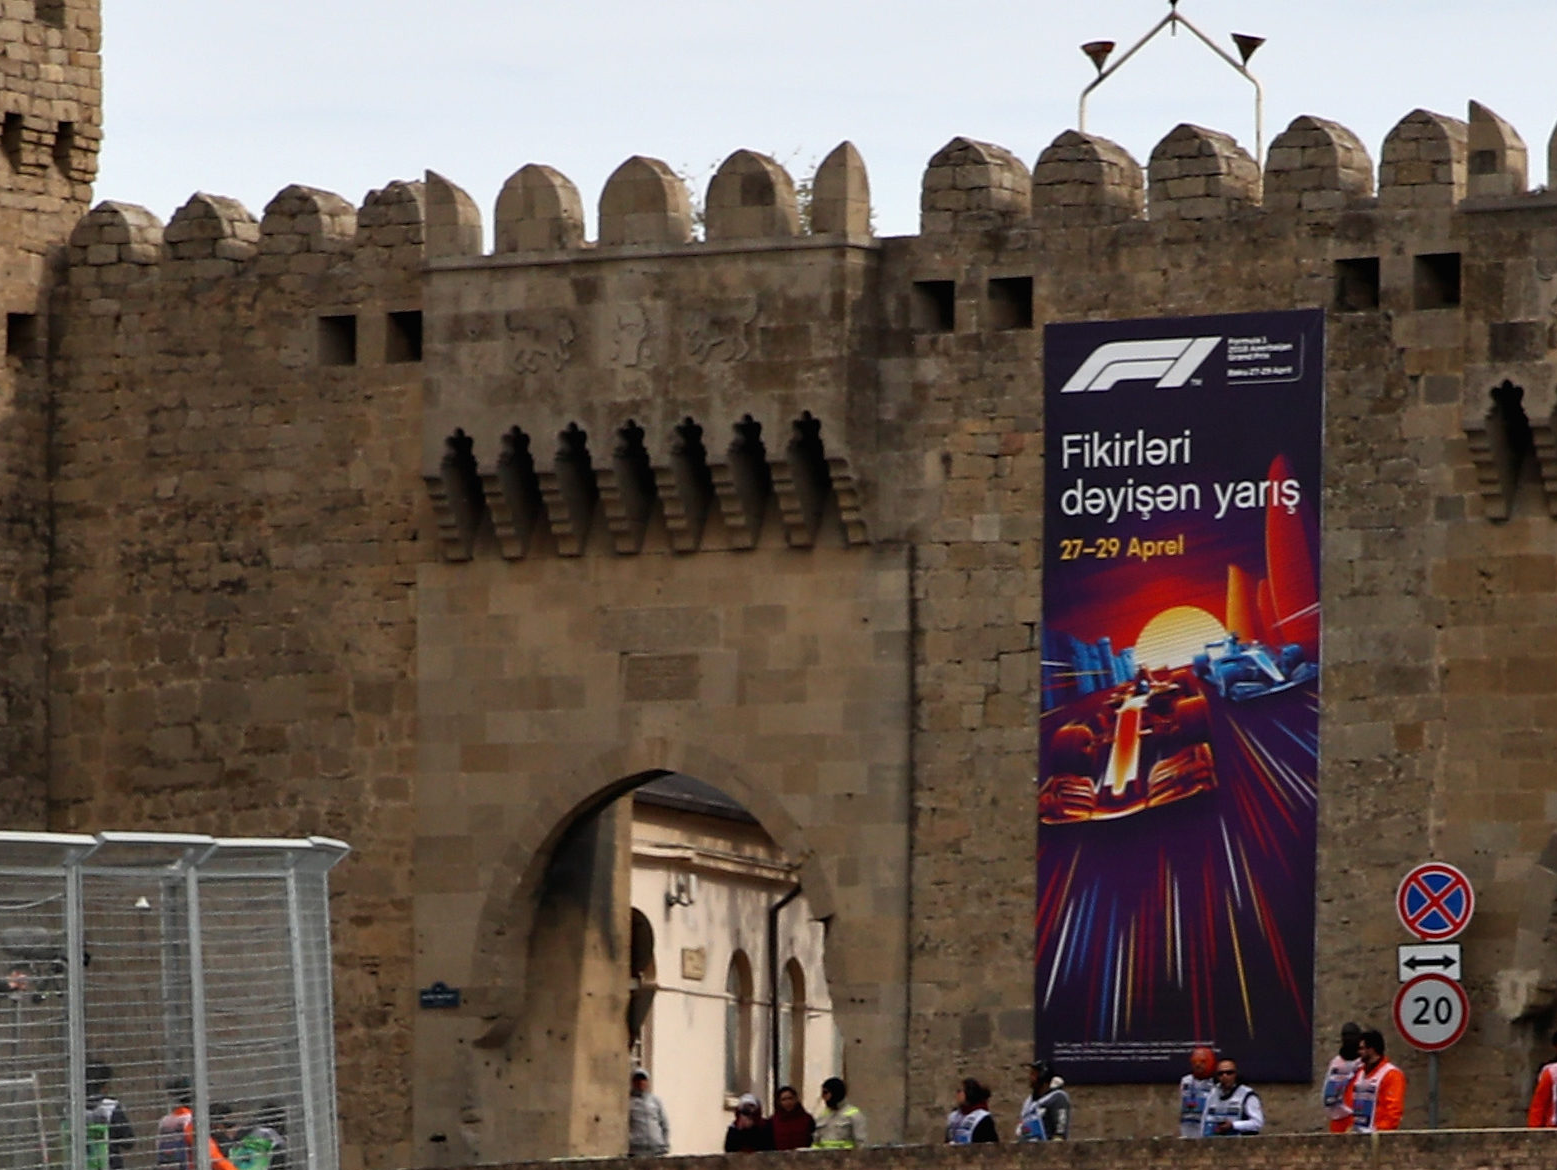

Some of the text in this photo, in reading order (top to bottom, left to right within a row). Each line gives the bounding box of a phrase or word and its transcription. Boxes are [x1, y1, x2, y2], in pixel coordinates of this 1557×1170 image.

[1062, 430, 1191, 469] Fikirləri
[1061, 479, 1301, 523] dəyişən yarış
[1126, 534, 1184, 562] Aprel
[1411, 996, 1453, 1025] 20
